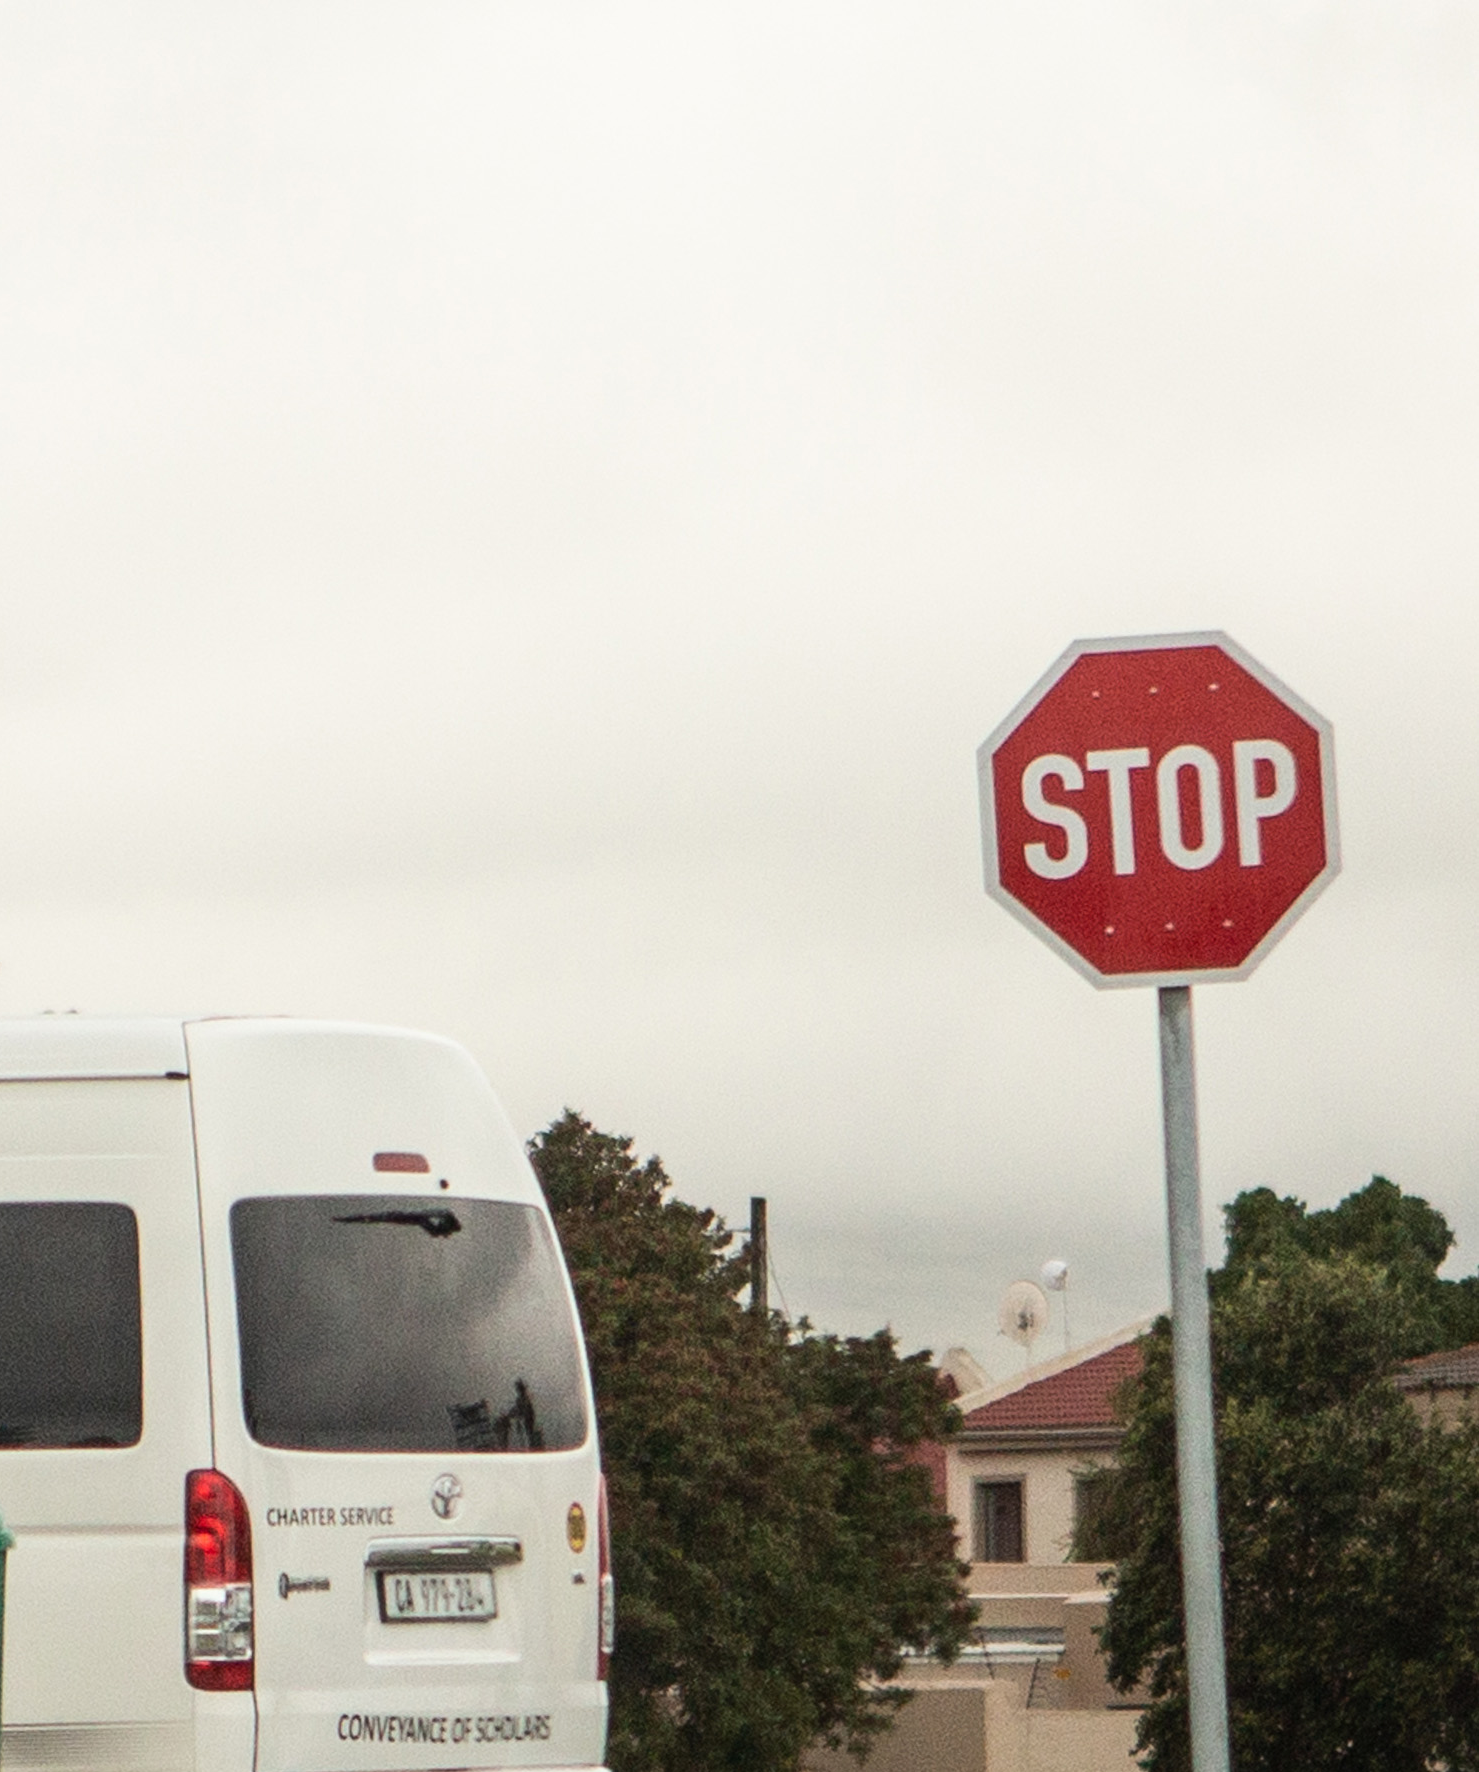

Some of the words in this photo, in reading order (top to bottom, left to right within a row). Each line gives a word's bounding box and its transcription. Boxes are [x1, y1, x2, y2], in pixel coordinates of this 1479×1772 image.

[1021, 739, 1298, 880] STOP
[266, 1506, 336, 1527] CHARTER
[339, 1506, 394, 1526] SERVICE
[338, 1713, 447, 1743] CONVEYANCE
[451, 1716, 473, 1743] OF
[475, 1714, 551, 1743] SCHOLARS
